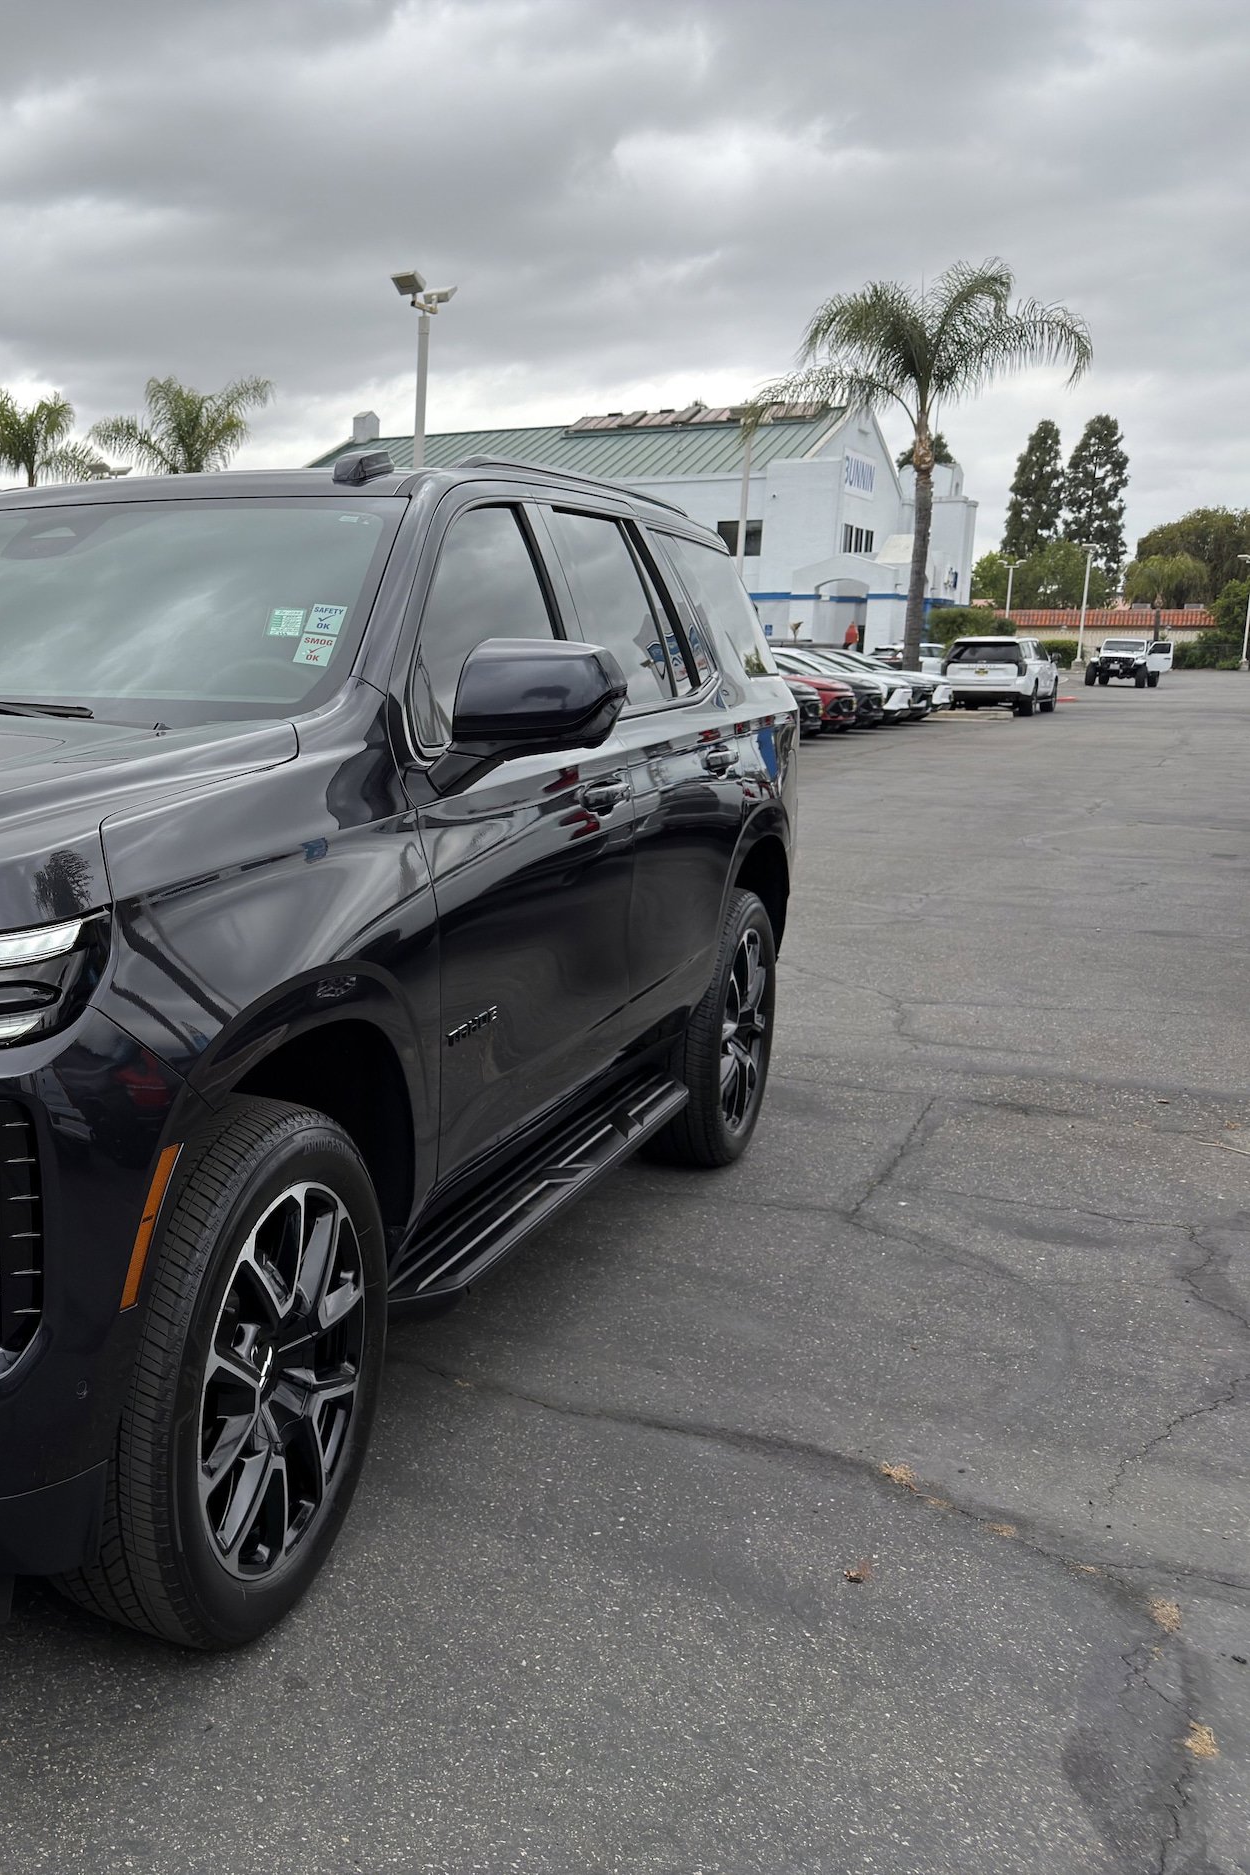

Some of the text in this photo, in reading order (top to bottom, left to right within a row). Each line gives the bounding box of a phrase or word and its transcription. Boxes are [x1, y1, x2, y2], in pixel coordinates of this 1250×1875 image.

[313, 606, 345, 615] SAFETY
[316, 622, 331, 630] OK
[304, 636, 334, 646] SMOG
[305, 654, 320, 662] OK
[445, 1005, 498, 1047] TAHOE
